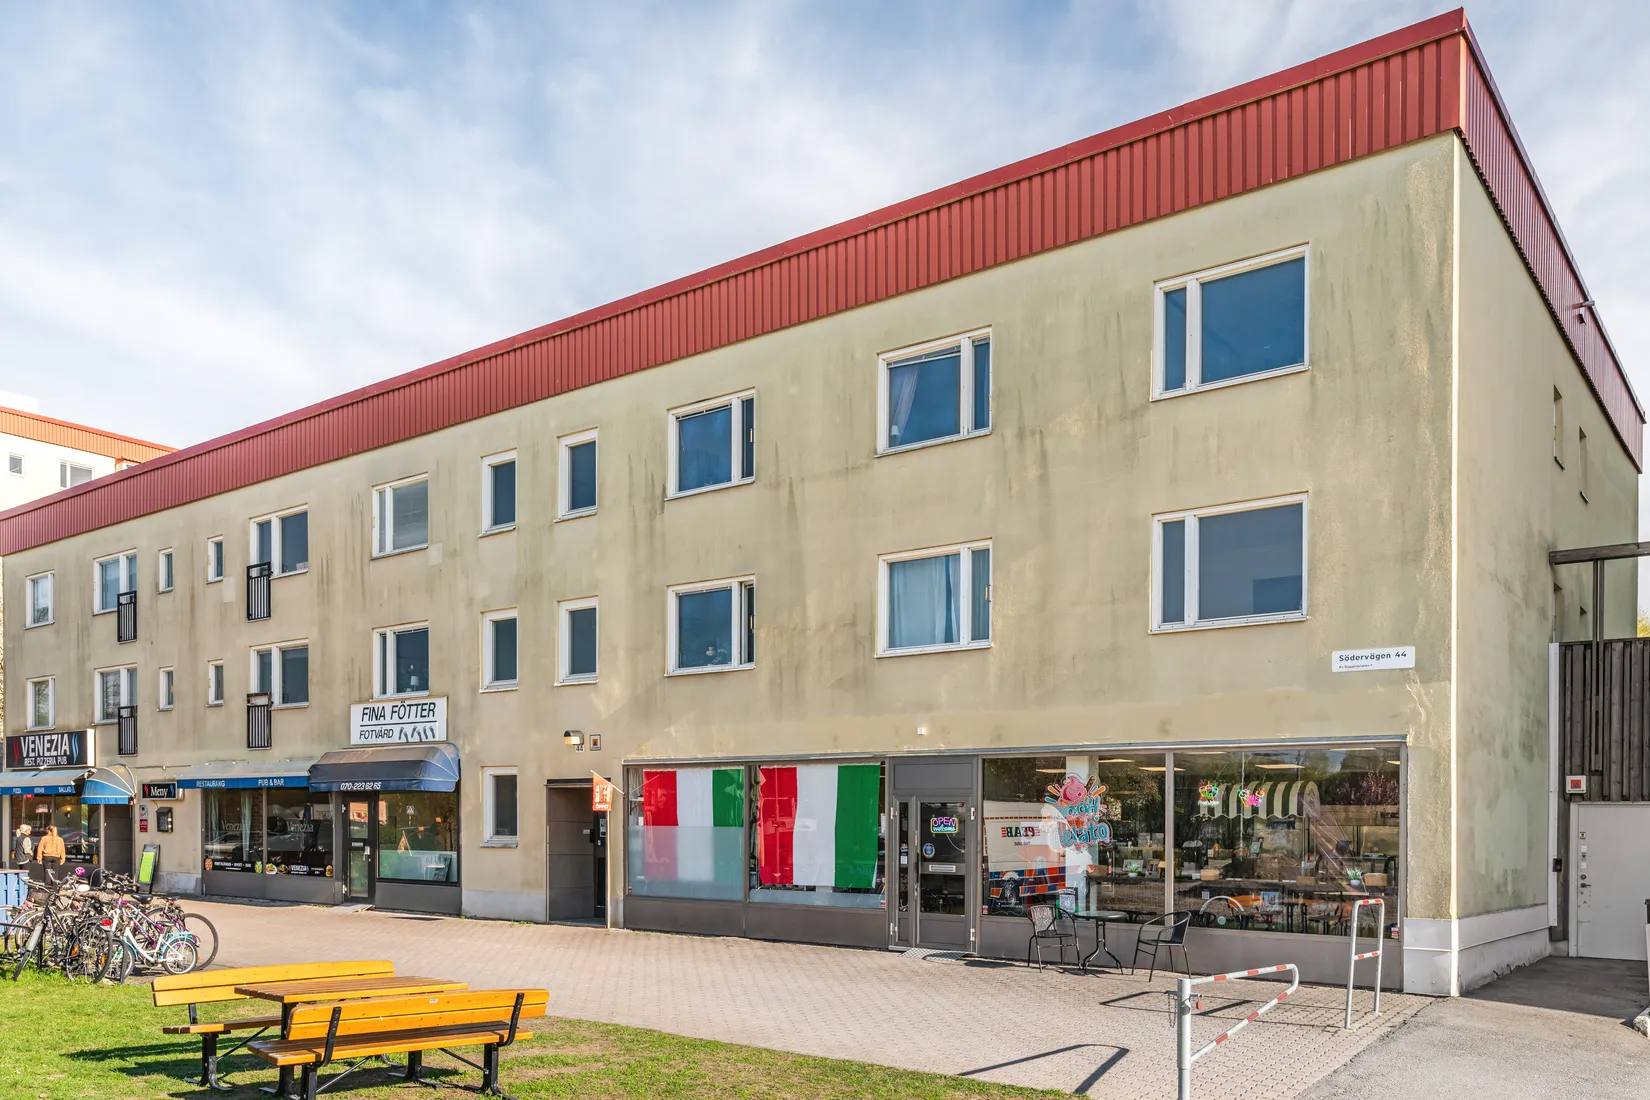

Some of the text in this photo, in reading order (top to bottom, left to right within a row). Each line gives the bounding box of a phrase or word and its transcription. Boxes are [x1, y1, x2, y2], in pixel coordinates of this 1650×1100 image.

[1338, 650, 1407, 662] Södervägen 44
[361, 700, 436, 722] FINA FÖTTER
[359, 727, 394, 740] FOTVÅRD
[20, 733, 70, 758] VENEZIA
[36, 756, 57, 766] PIZZERIA
[57, 755, 68, 765] PUB
[195, 780, 226, 788] RESTAURANG
[258, 779, 269, 787] PUB
[273, 778, 285, 786] BAR
[150, 786, 169, 799] Meny
[932, 816, 957, 827] OPEN
